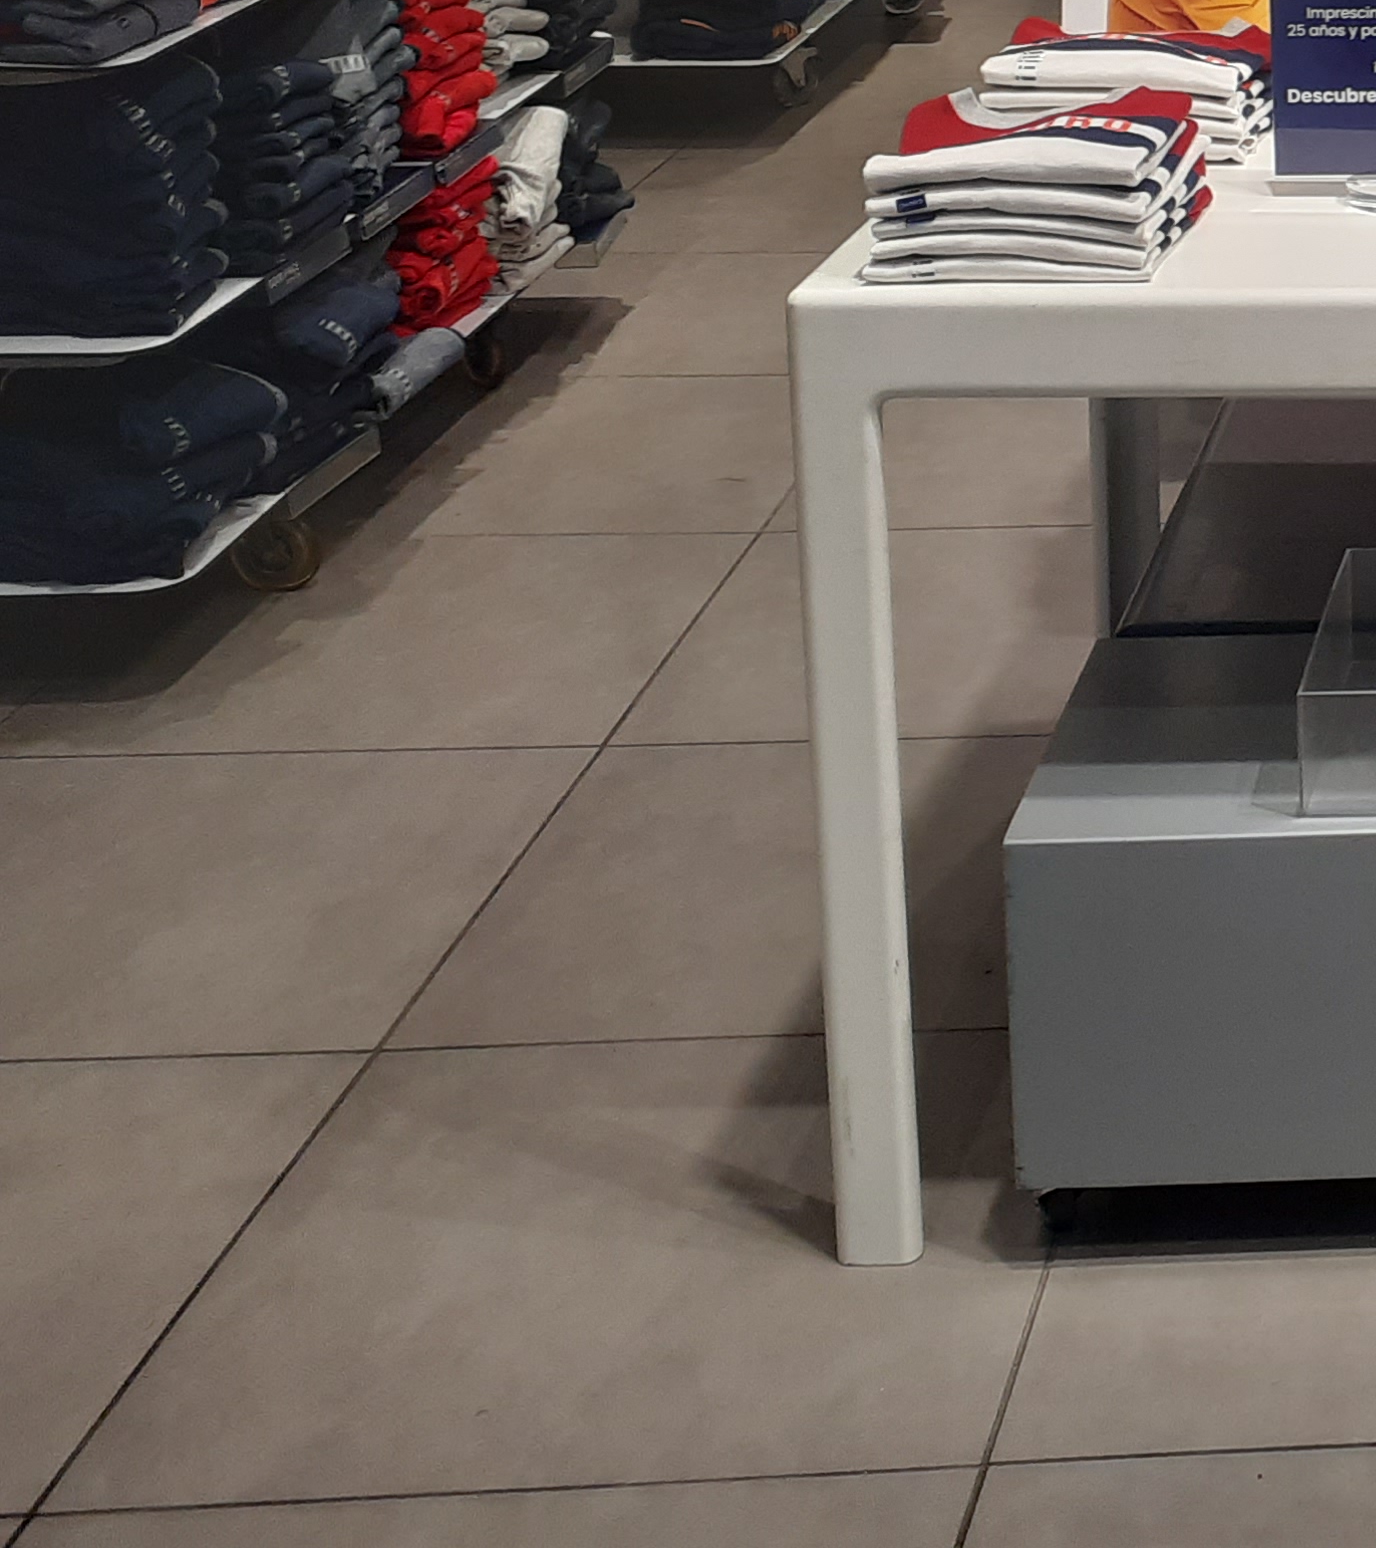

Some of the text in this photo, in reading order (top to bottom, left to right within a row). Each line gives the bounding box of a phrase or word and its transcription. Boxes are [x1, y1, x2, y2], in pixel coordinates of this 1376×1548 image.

[1286, 23, 1306, 37] 25
[1308, 24, 1347, 37] años
[1348, 26, 1359, 40] y
